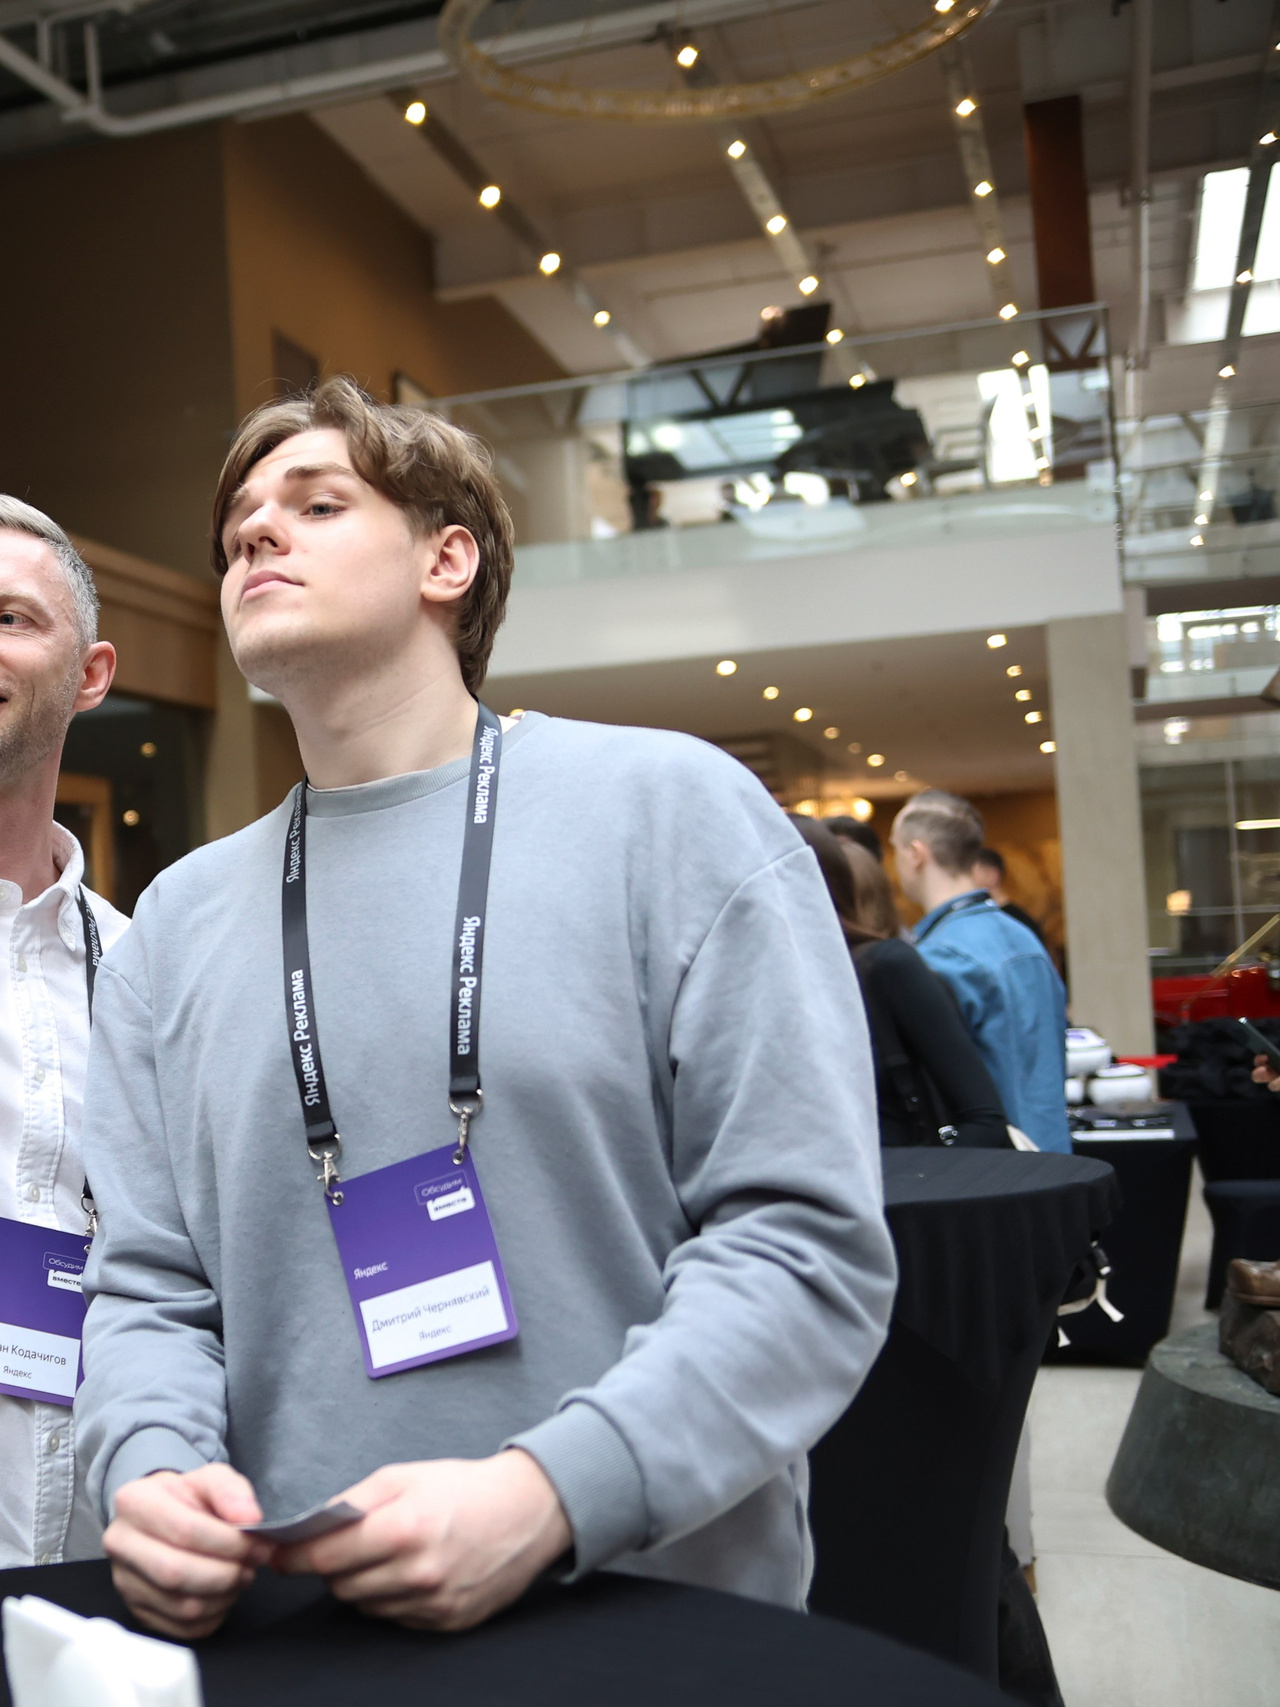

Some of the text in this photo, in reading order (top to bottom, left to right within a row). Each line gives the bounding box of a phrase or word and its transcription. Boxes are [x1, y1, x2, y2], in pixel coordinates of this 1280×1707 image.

[473, 725, 499, 824] Яндекс Реклама
[285, 836, 301, 883] Яндекс
[457, 916, 481, 1055] Яндекс Реклама
[291, 969, 320, 1106] Яндекс Реклама
[48, 1257, 84, 1270] Обсудим
[353, 1262, 389, 1280] Яндекс
[52, 1276, 82, 1286] вместе
[371, 1284, 490, 1333] Дмитрий Чернявский
[418, 1325, 452, 1341] Яндекс
[10, 1344, 67, 1366] Кодачигов
[2, 1365, 32, 1380] Яндекс
